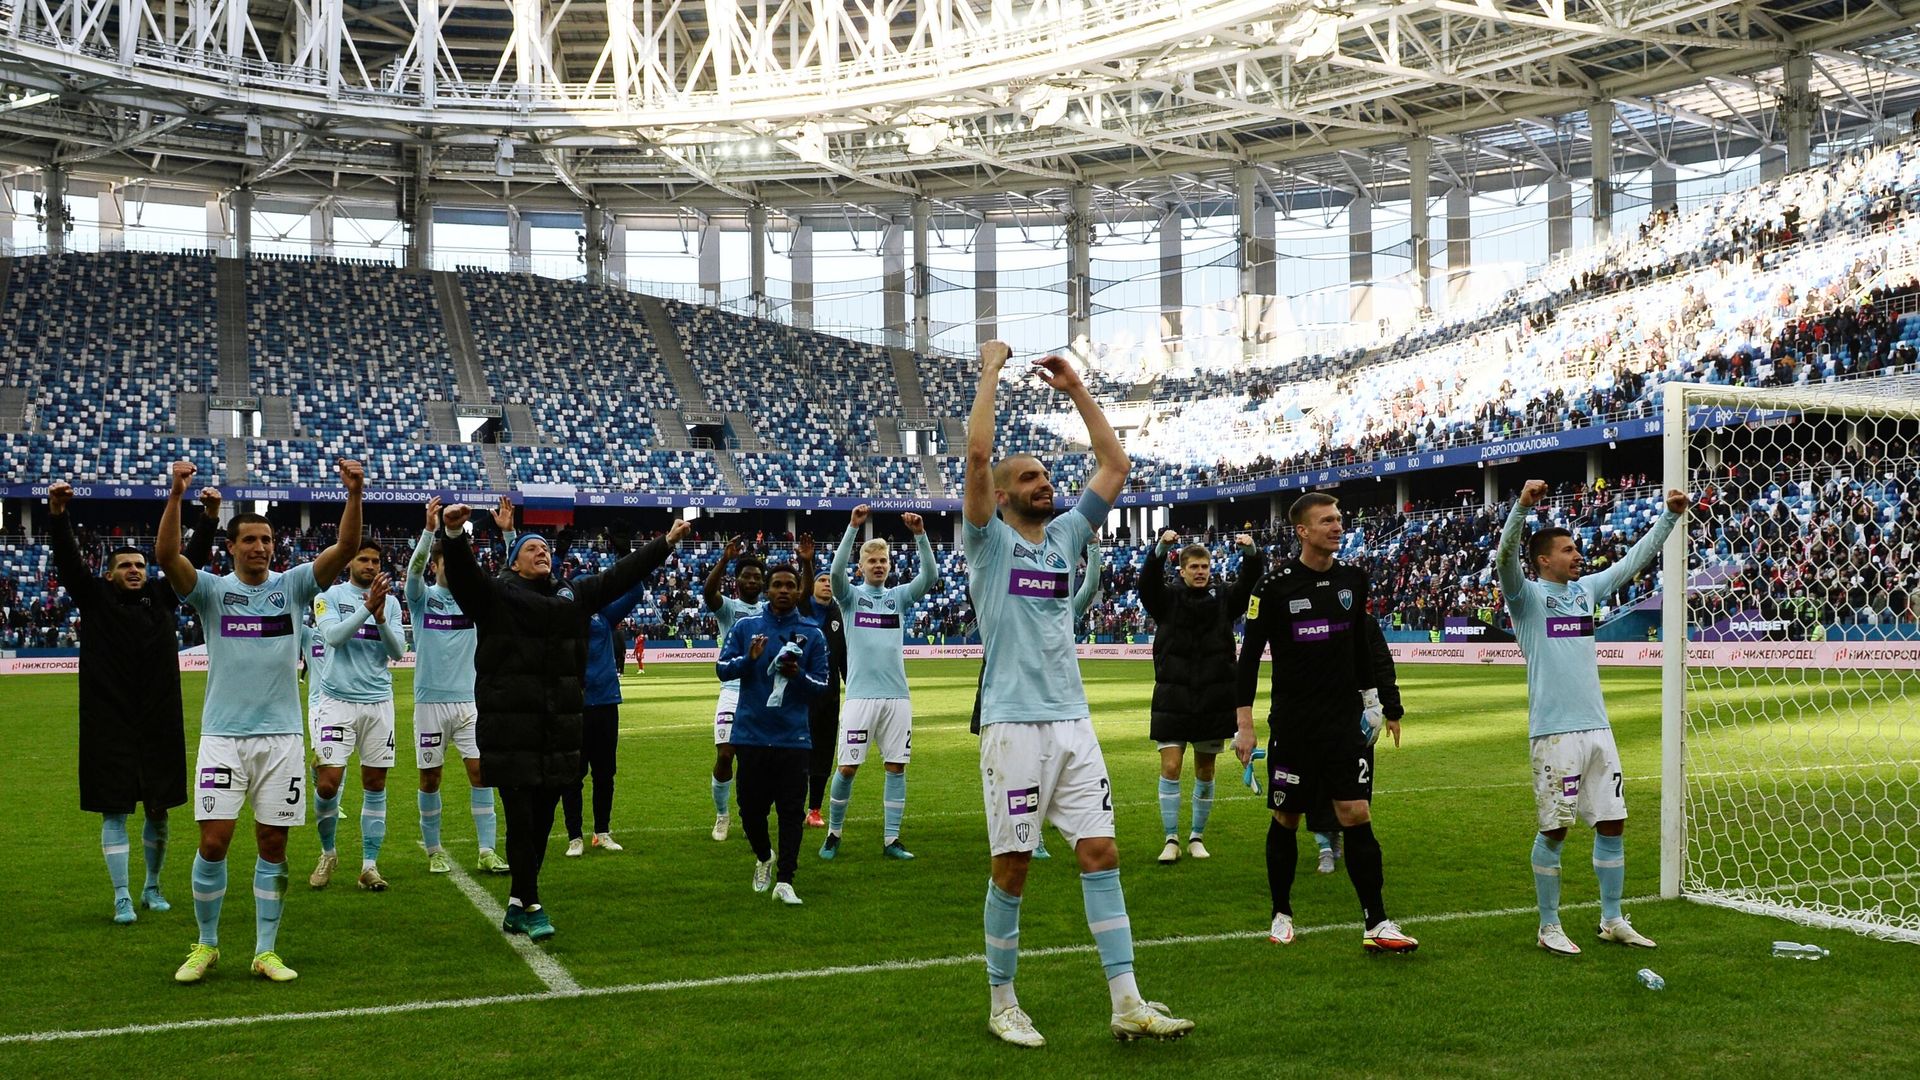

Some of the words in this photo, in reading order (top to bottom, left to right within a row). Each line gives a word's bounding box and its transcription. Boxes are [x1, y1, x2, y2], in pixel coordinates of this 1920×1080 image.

[1481, 445, 1507, 459] ДОБРО
[1507, 436, 1560, 453] ПОЖАЛОВАТЬ
[1216, 482, 1245, 496] НИЖНИЙ
[361, 491, 393, 501] ОВОГО
[395, 491, 432, 501] ВЫЗОВА
[871, 499, 914, 509] НИЖНИЙ
[1445, 626, 1487, 636] PARIBET
[1729, 620, 1790, 632] PARIBET
[1418, 650, 1464, 658] НИЖЕГОРОДЕЦ
[1486, 650, 1523, 658] НИЖЕГОРО
[322, 729, 343, 739] PB
[421, 735, 440, 744] PB
[847, 733, 867, 741] PB
[386, 730, 395, 751] 4
[1358, 758, 1370, 784] 2
[201, 772, 231, 784] PB
[1274, 770, 1300, 785] PB
[286, 776, 302, 805] 5
[1612, 772, 1622, 798] 7
[1100, 778, 1112, 811] 2
[1009, 792, 1039, 810] PB
